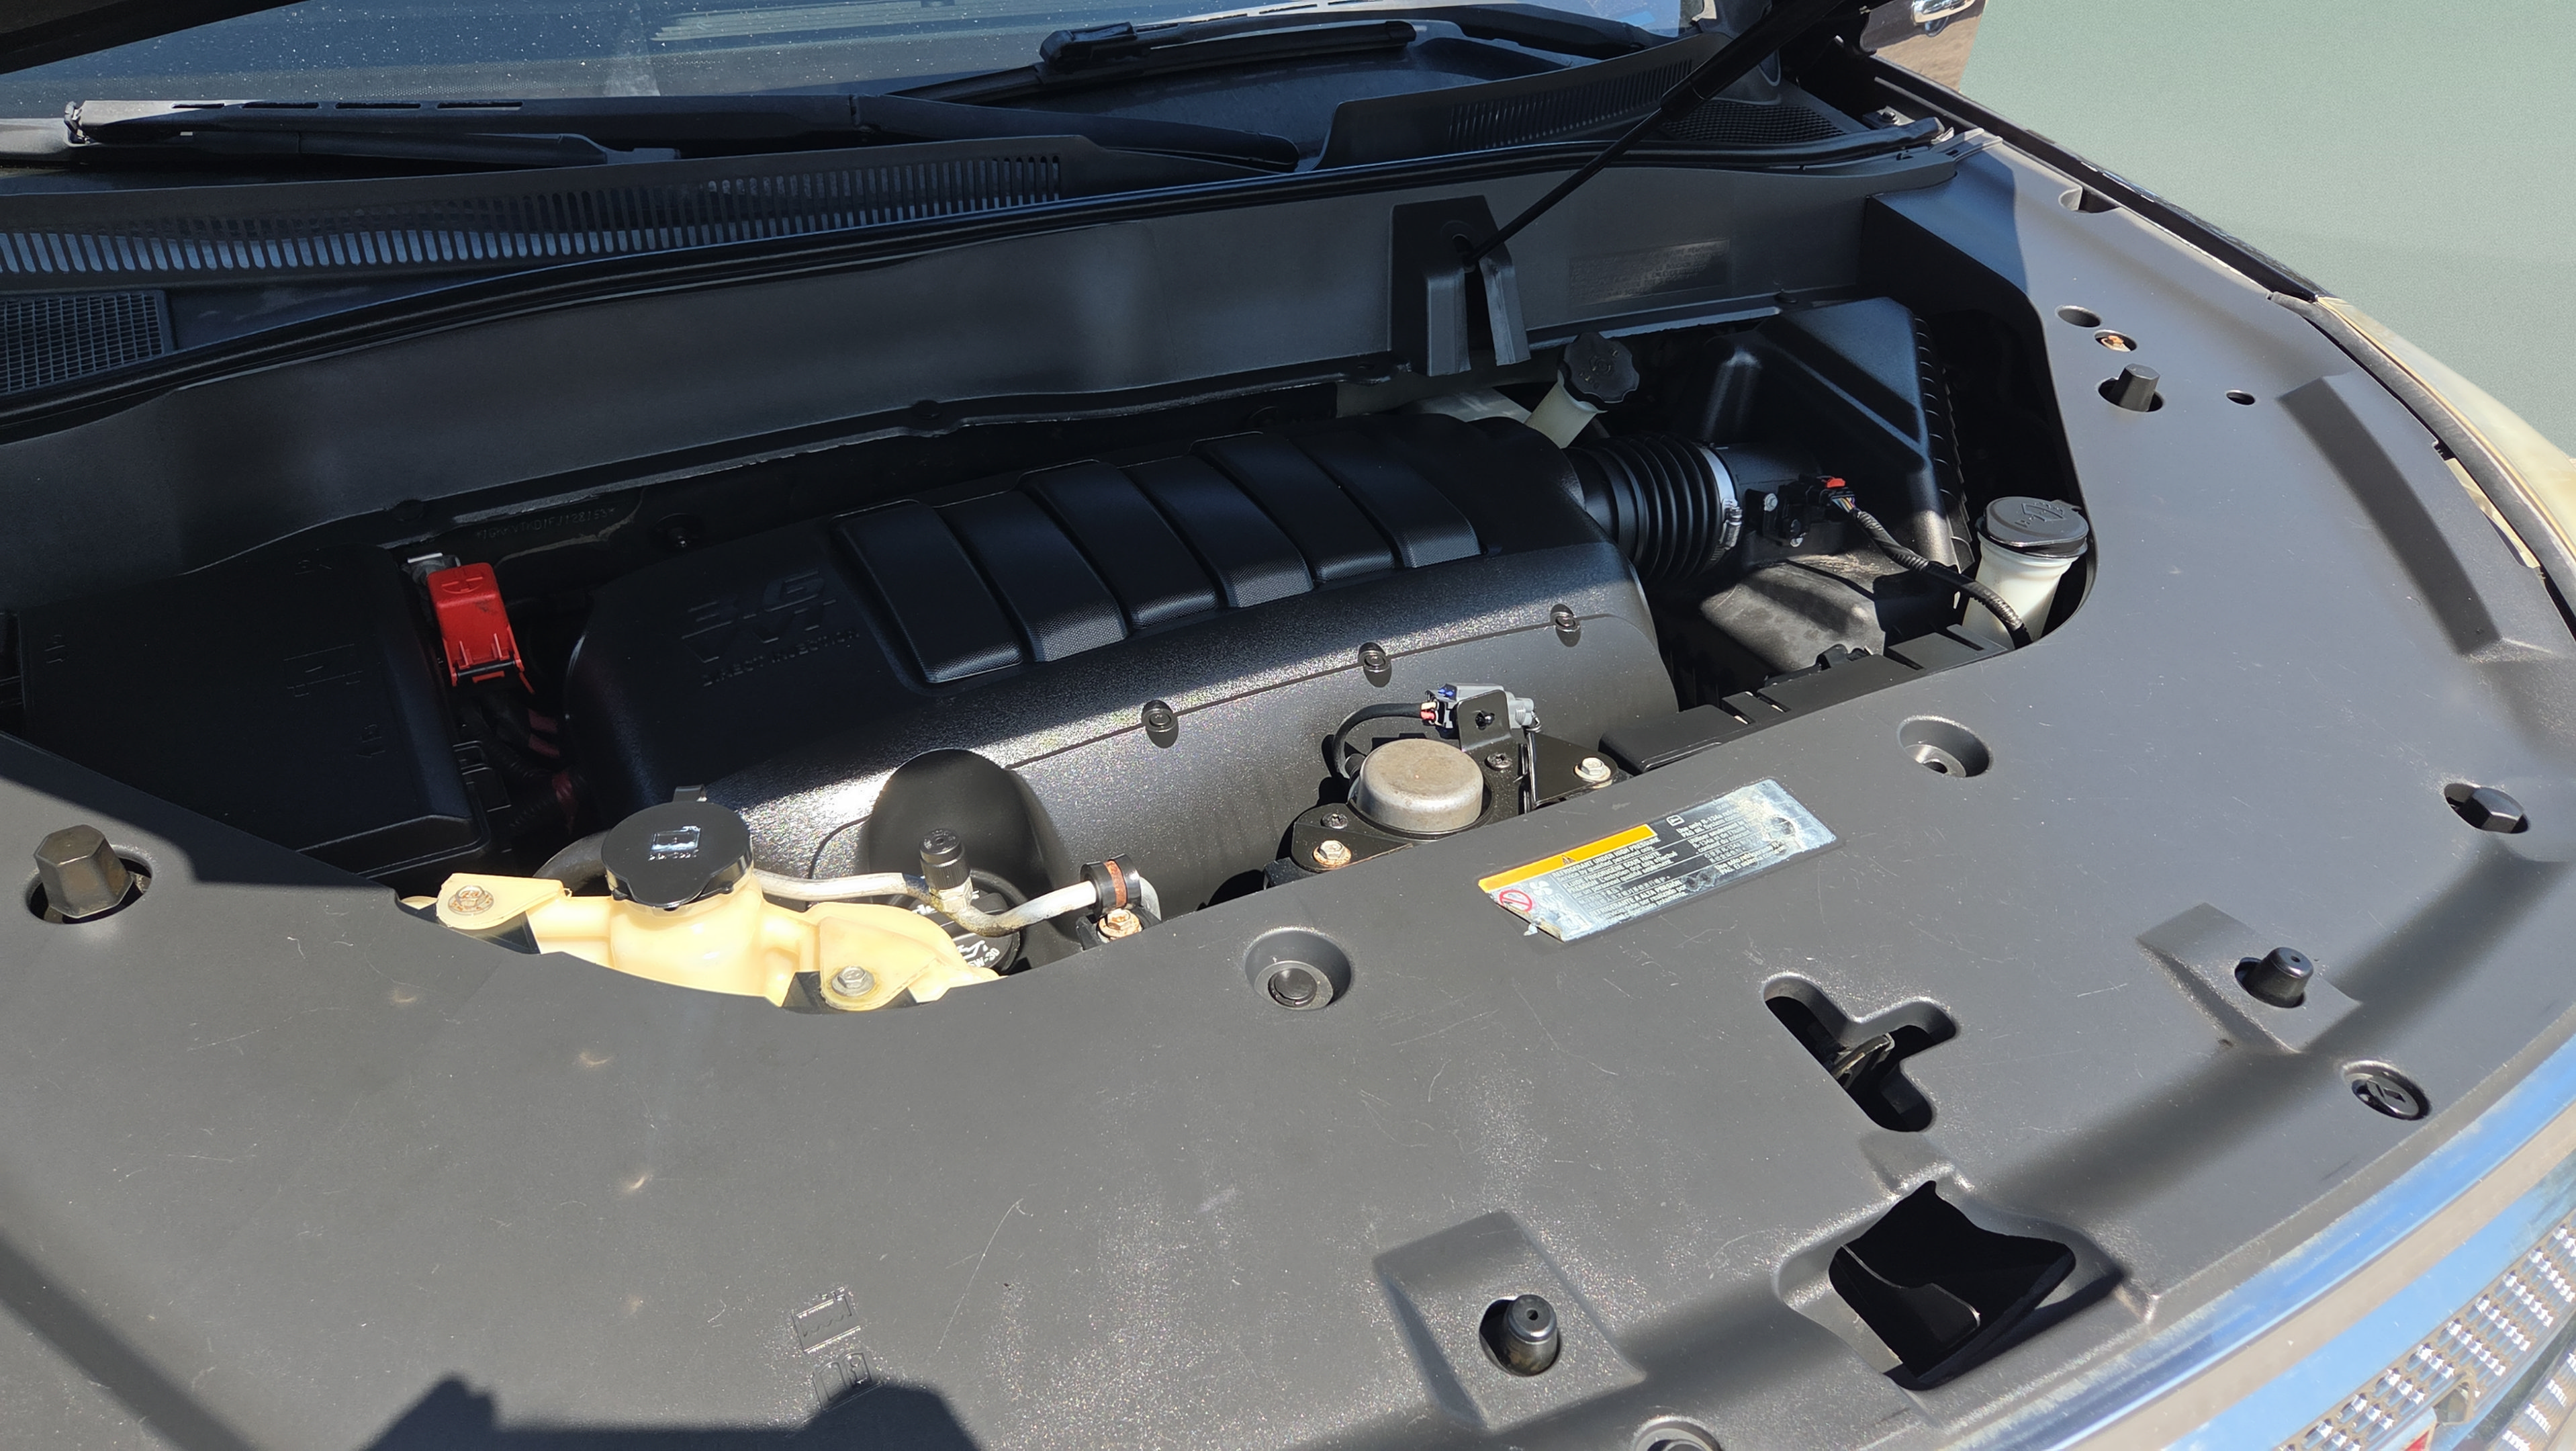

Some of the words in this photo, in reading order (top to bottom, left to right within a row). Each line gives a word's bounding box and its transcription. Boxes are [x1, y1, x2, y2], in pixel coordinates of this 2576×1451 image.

[1703, 819, 1726, 829] System
[1552, 860, 1593, 877] REFRIGERANT
[1592, 852, 1614, 863] UNDER
[1613, 847, 1630, 856] HIGH
[1628, 836, 1661, 850] PRESSURE
[1556, 872, 1579, 882] Service
[1587, 860, 1612, 872] qualified
[1612, 849, 1641, 864] personnel
[1653, 850, 1677, 863] effectué
[1562, 877, 1585, 888] FLUIDE
[1622, 858, 1641, 867] SOUS
[1639, 850, 1661, 861] HAUTE
[1591, 877, 1620, 893] personnel
[1620, 870, 1643, 882] qualifié
[1639, 889, 1656, 899] ALTA
[1652, 878, 1682, 892] PRESIÓN
